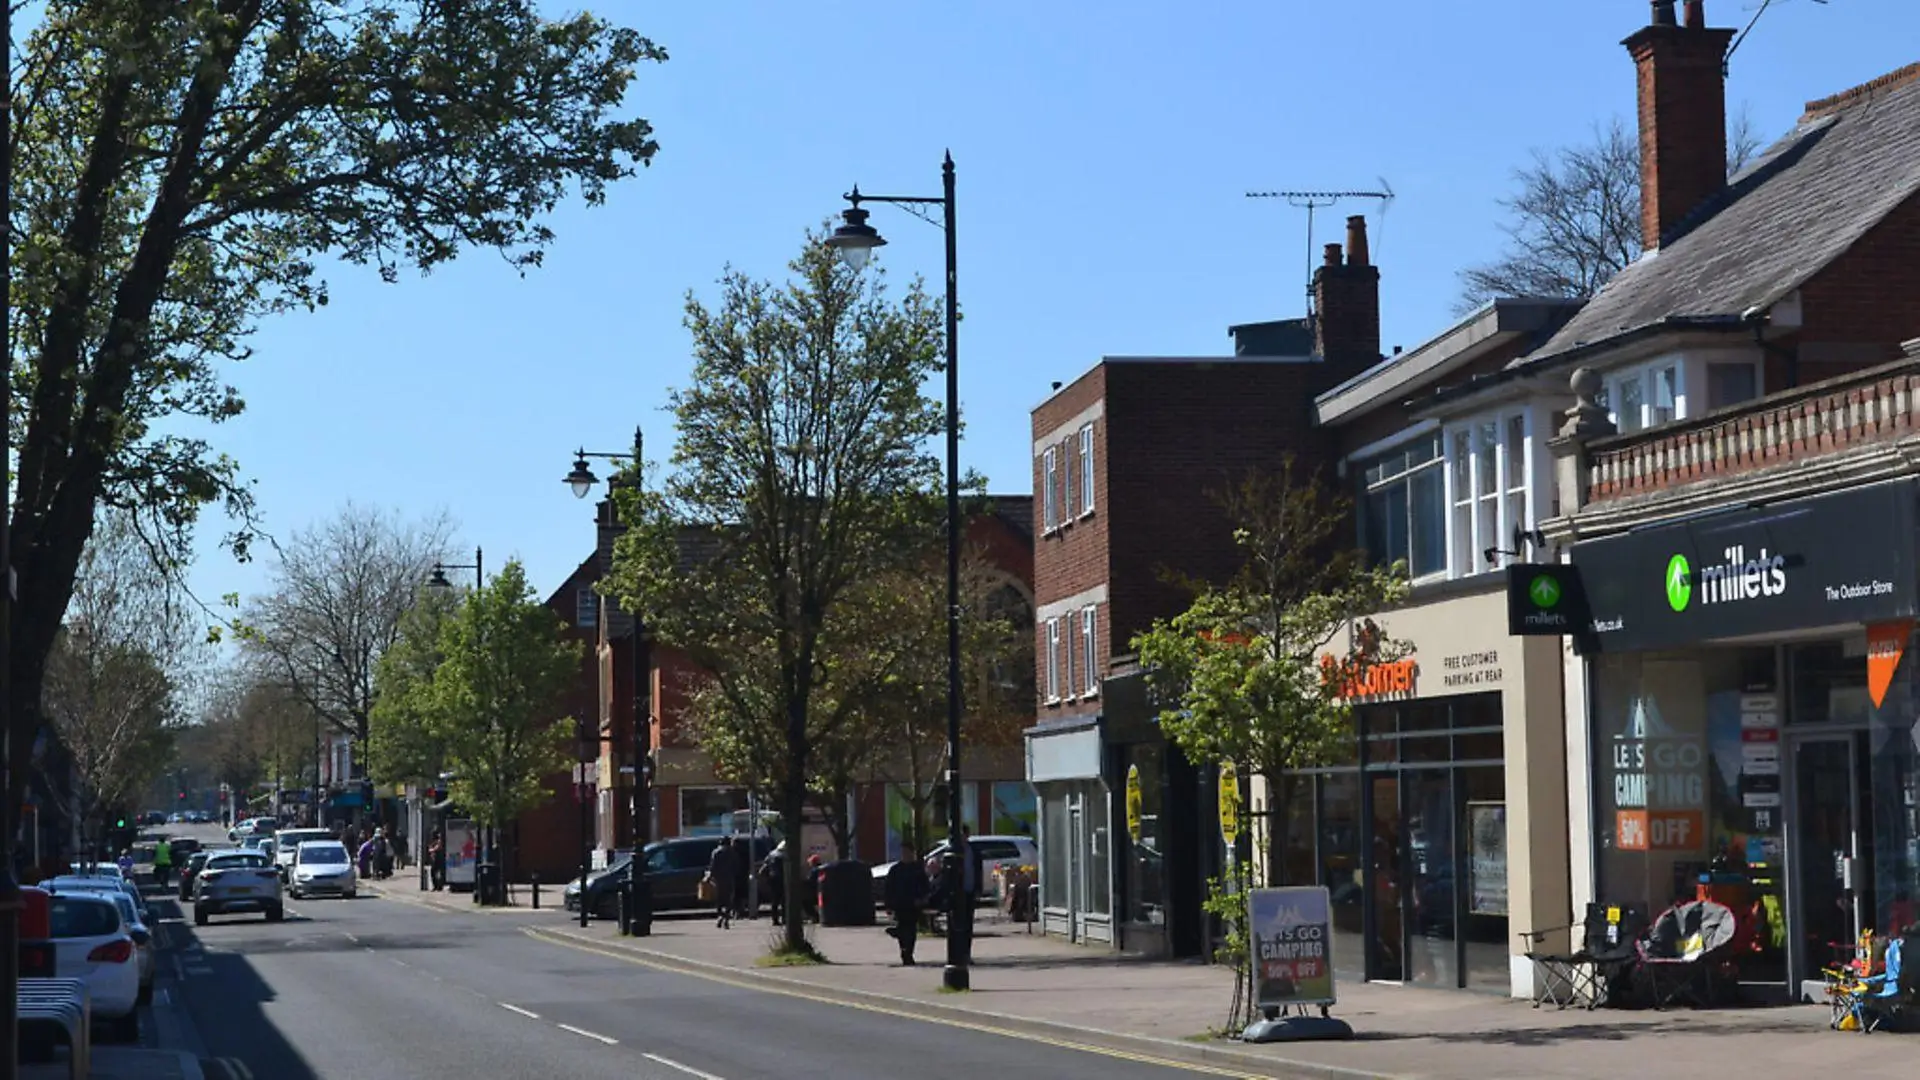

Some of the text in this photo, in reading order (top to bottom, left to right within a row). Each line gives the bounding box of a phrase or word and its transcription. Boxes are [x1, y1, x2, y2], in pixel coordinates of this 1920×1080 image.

[1701, 545, 1786, 604] millets
[1825, 579, 1893, 601] The Outdoor Store
[1525, 611, 1567, 625] millets
[1444, 650, 1498, 669] FREE CUSTOMER
[1444, 672, 1474, 686] PARKING
[1485, 668, 1503, 682] REAR
[1652, 743, 1701, 768] GO
[1615, 773, 1703, 807] CAMPING
[1621, 818, 1691, 846] 50% OFF
[1297, 926, 1321, 940] GO
[1261, 941, 1323, 960] CAMPING
[1296, 961, 1317, 977] OFF
